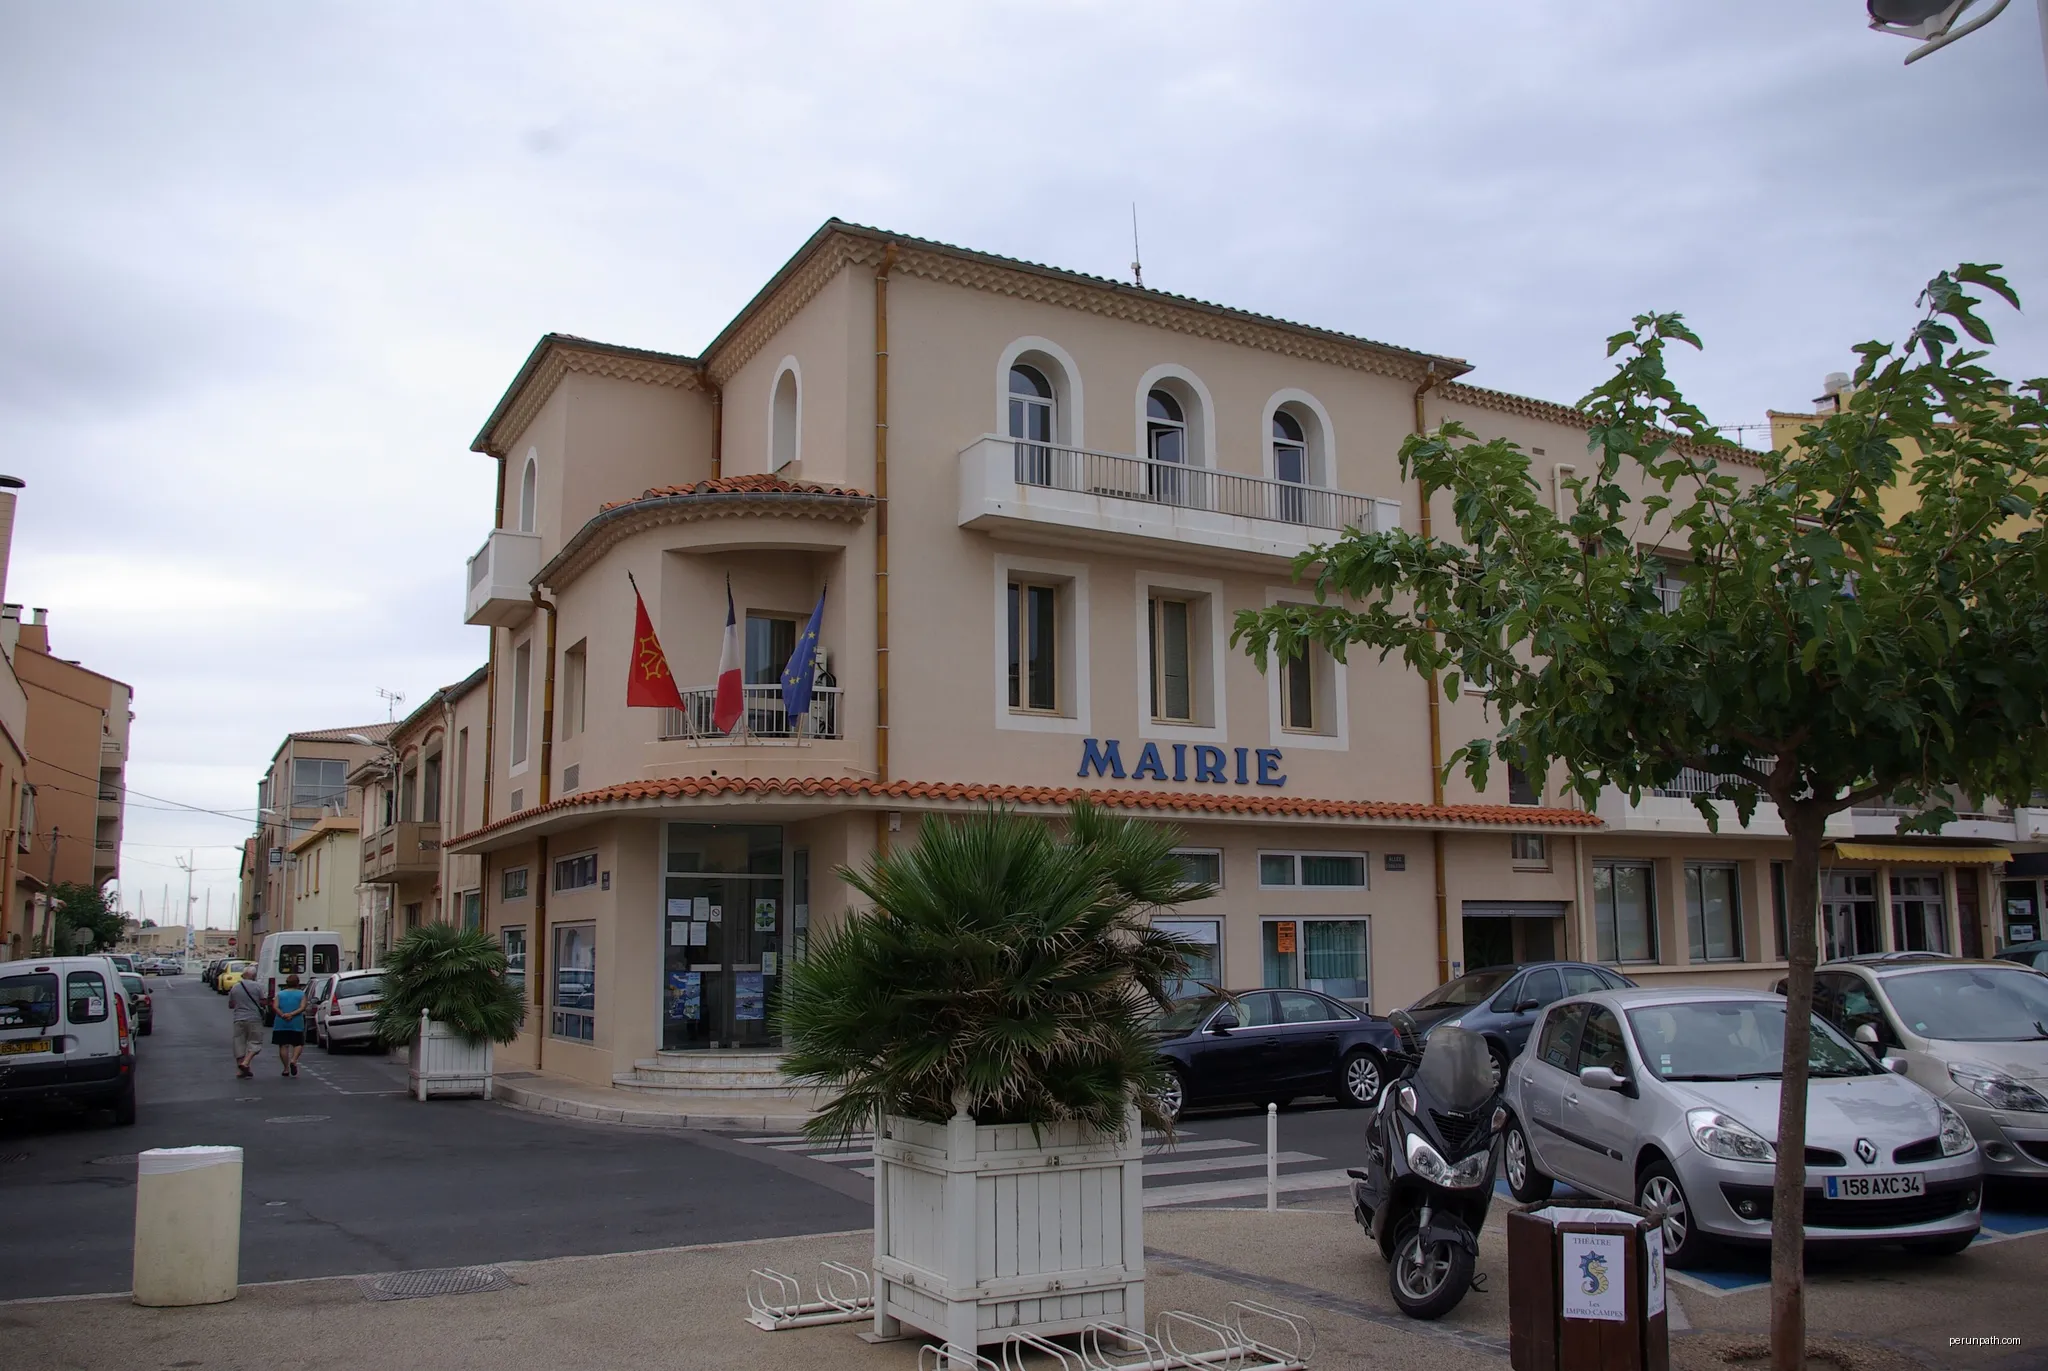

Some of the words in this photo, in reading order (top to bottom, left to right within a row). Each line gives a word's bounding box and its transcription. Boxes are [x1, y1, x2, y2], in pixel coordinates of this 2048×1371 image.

[1077, 738, 1287, 787] MAIRIE
[1842, 1178, 1869, 1196] 158
[1872, 1177, 1899, 1195] AXC
[1902, 1176, 1920, 1193] 34
[1589, 1300, 1600, 1308] Les
